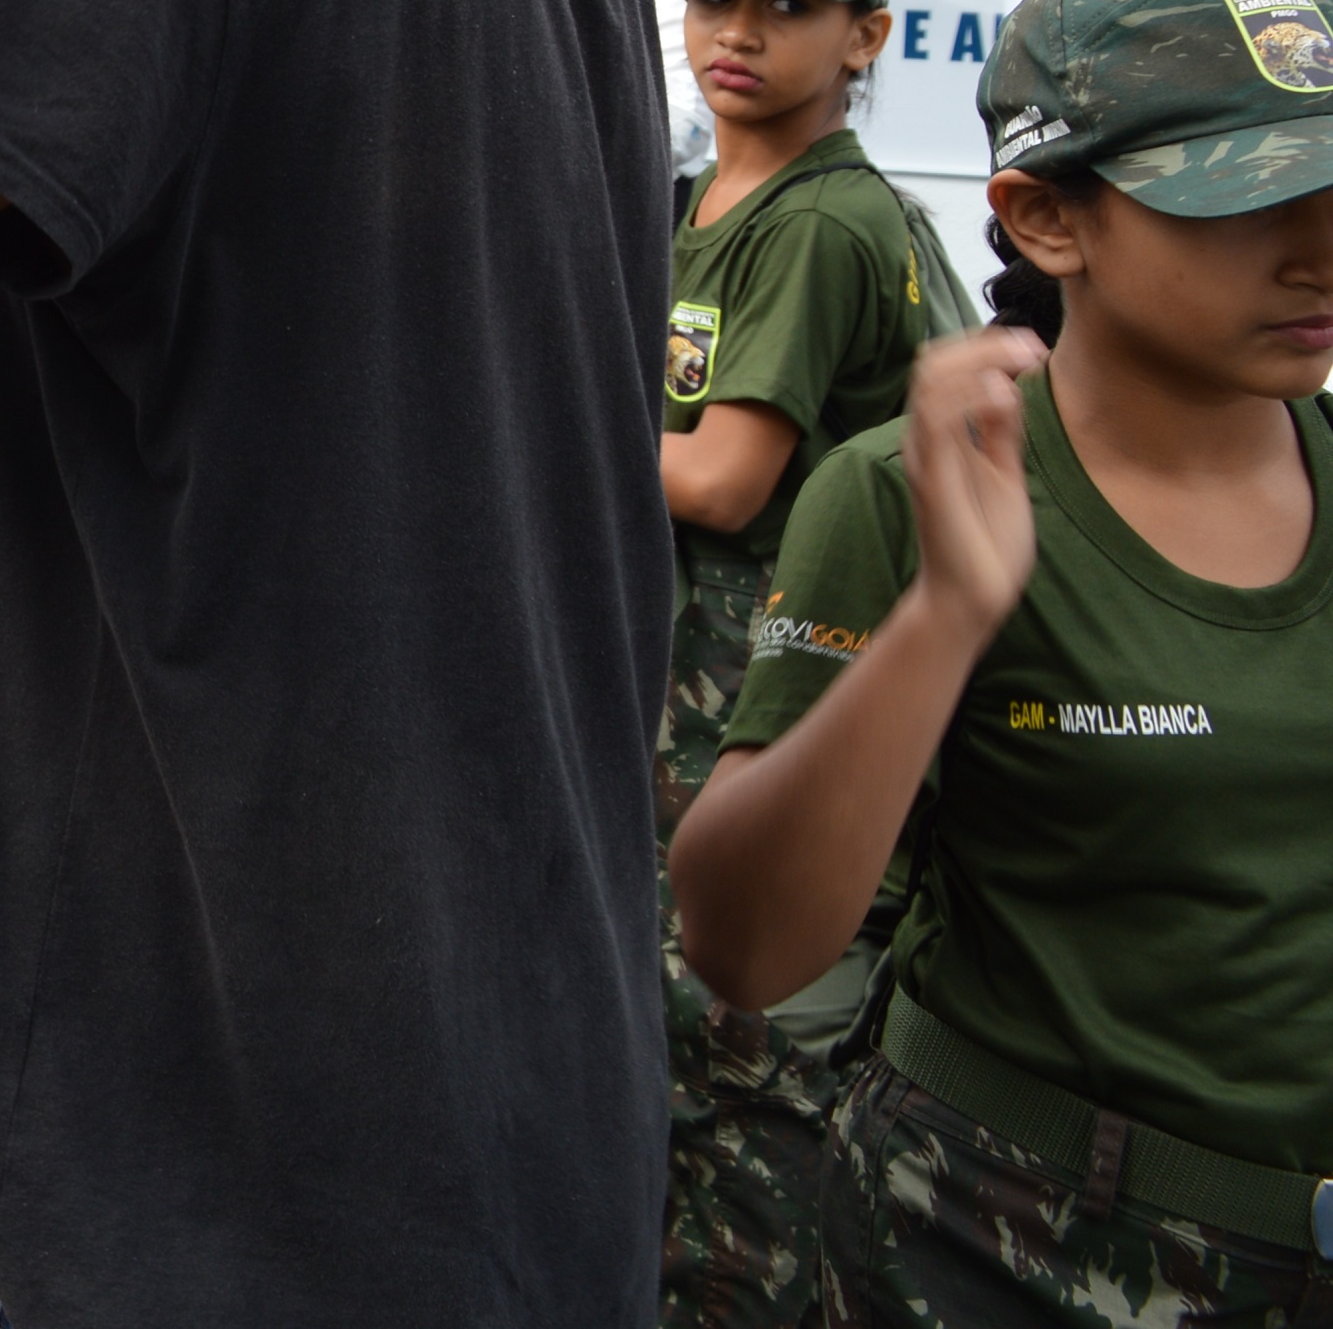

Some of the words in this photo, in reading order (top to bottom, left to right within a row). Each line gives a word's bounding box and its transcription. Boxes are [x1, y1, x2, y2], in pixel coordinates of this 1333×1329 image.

[903, 9, 930, 60] E
[1010, 701, 1045, 730] GAM
[1058, 703, 1138, 735] MAYLLA
[1137, 703, 1213, 736] BIANCA
